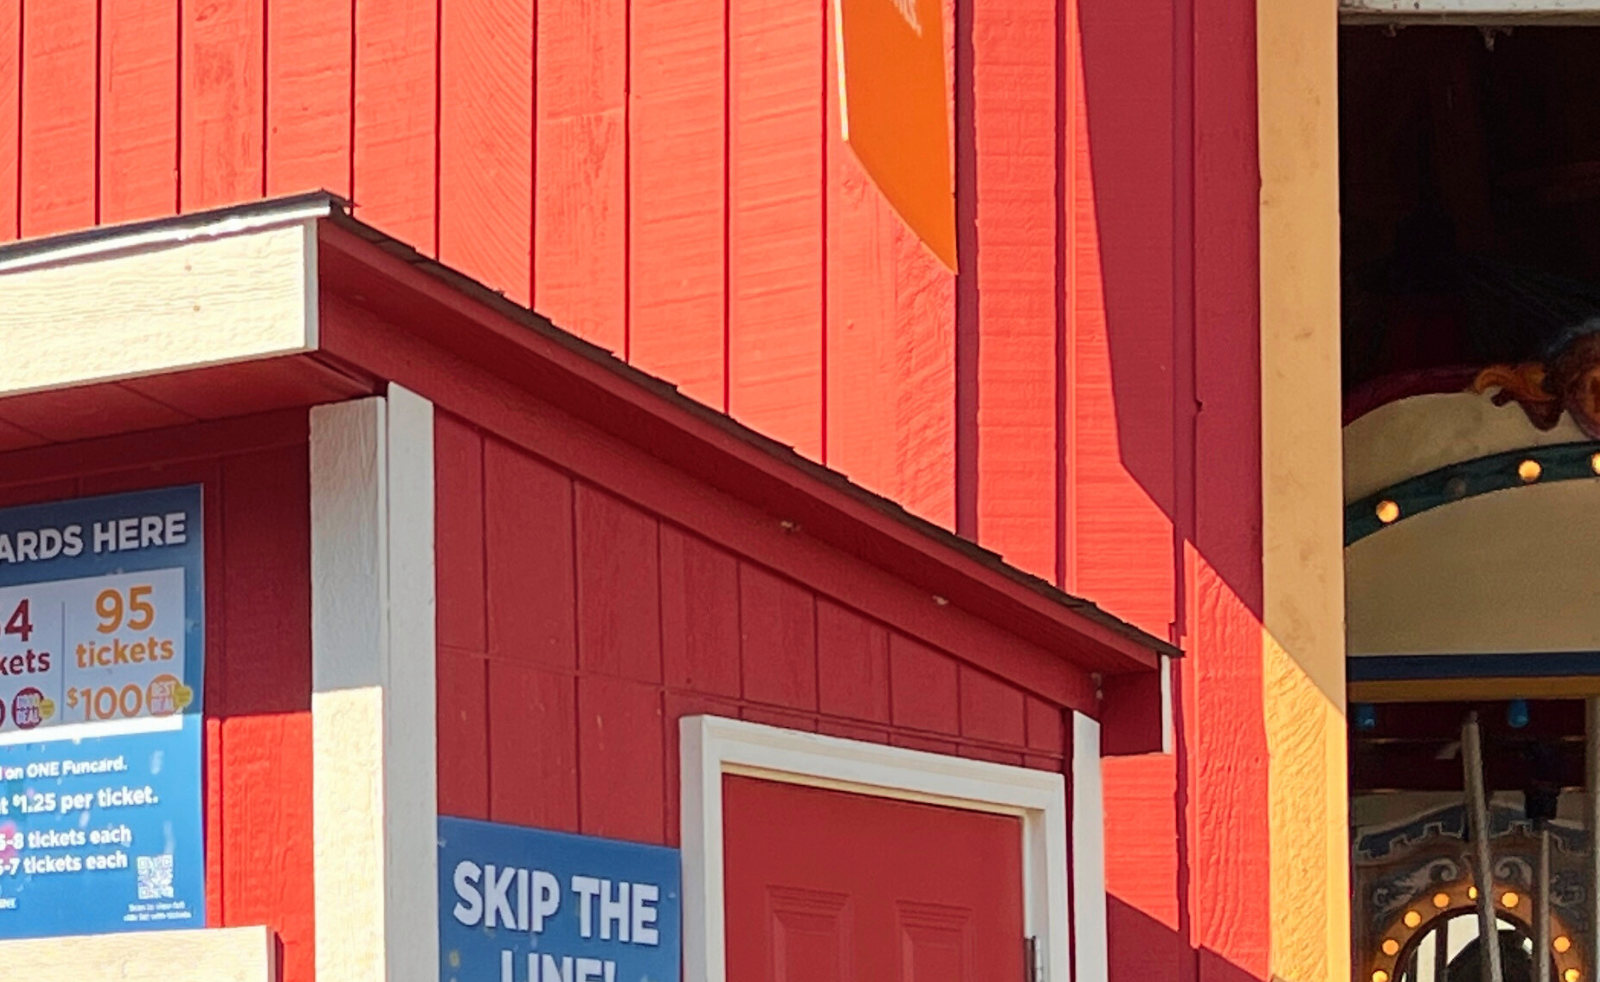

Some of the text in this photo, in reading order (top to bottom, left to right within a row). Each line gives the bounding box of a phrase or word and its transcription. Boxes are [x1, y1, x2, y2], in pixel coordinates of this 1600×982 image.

[93, 512, 187, 553] HERE
[95, 585, 155, 634] 95
[76, 637, 174, 668] tickets
[67, 683, 142, 721] $100
[4, 767, 23, 780] on
[26, 761, 60, 778] ONE
[62, 755, 128, 774] Funcard.
[12, 793, 56, 813] $1.25
[61, 792, 94, 813] per
[97, 785, 158, 808] ticket.
[28, 829, 86, 848] tickets
[90, 824, 132, 844] each
[24, 855, 82, 874] tickets
[86, 850, 128, 870] each
[453, 860, 659, 946] SKIP THE
